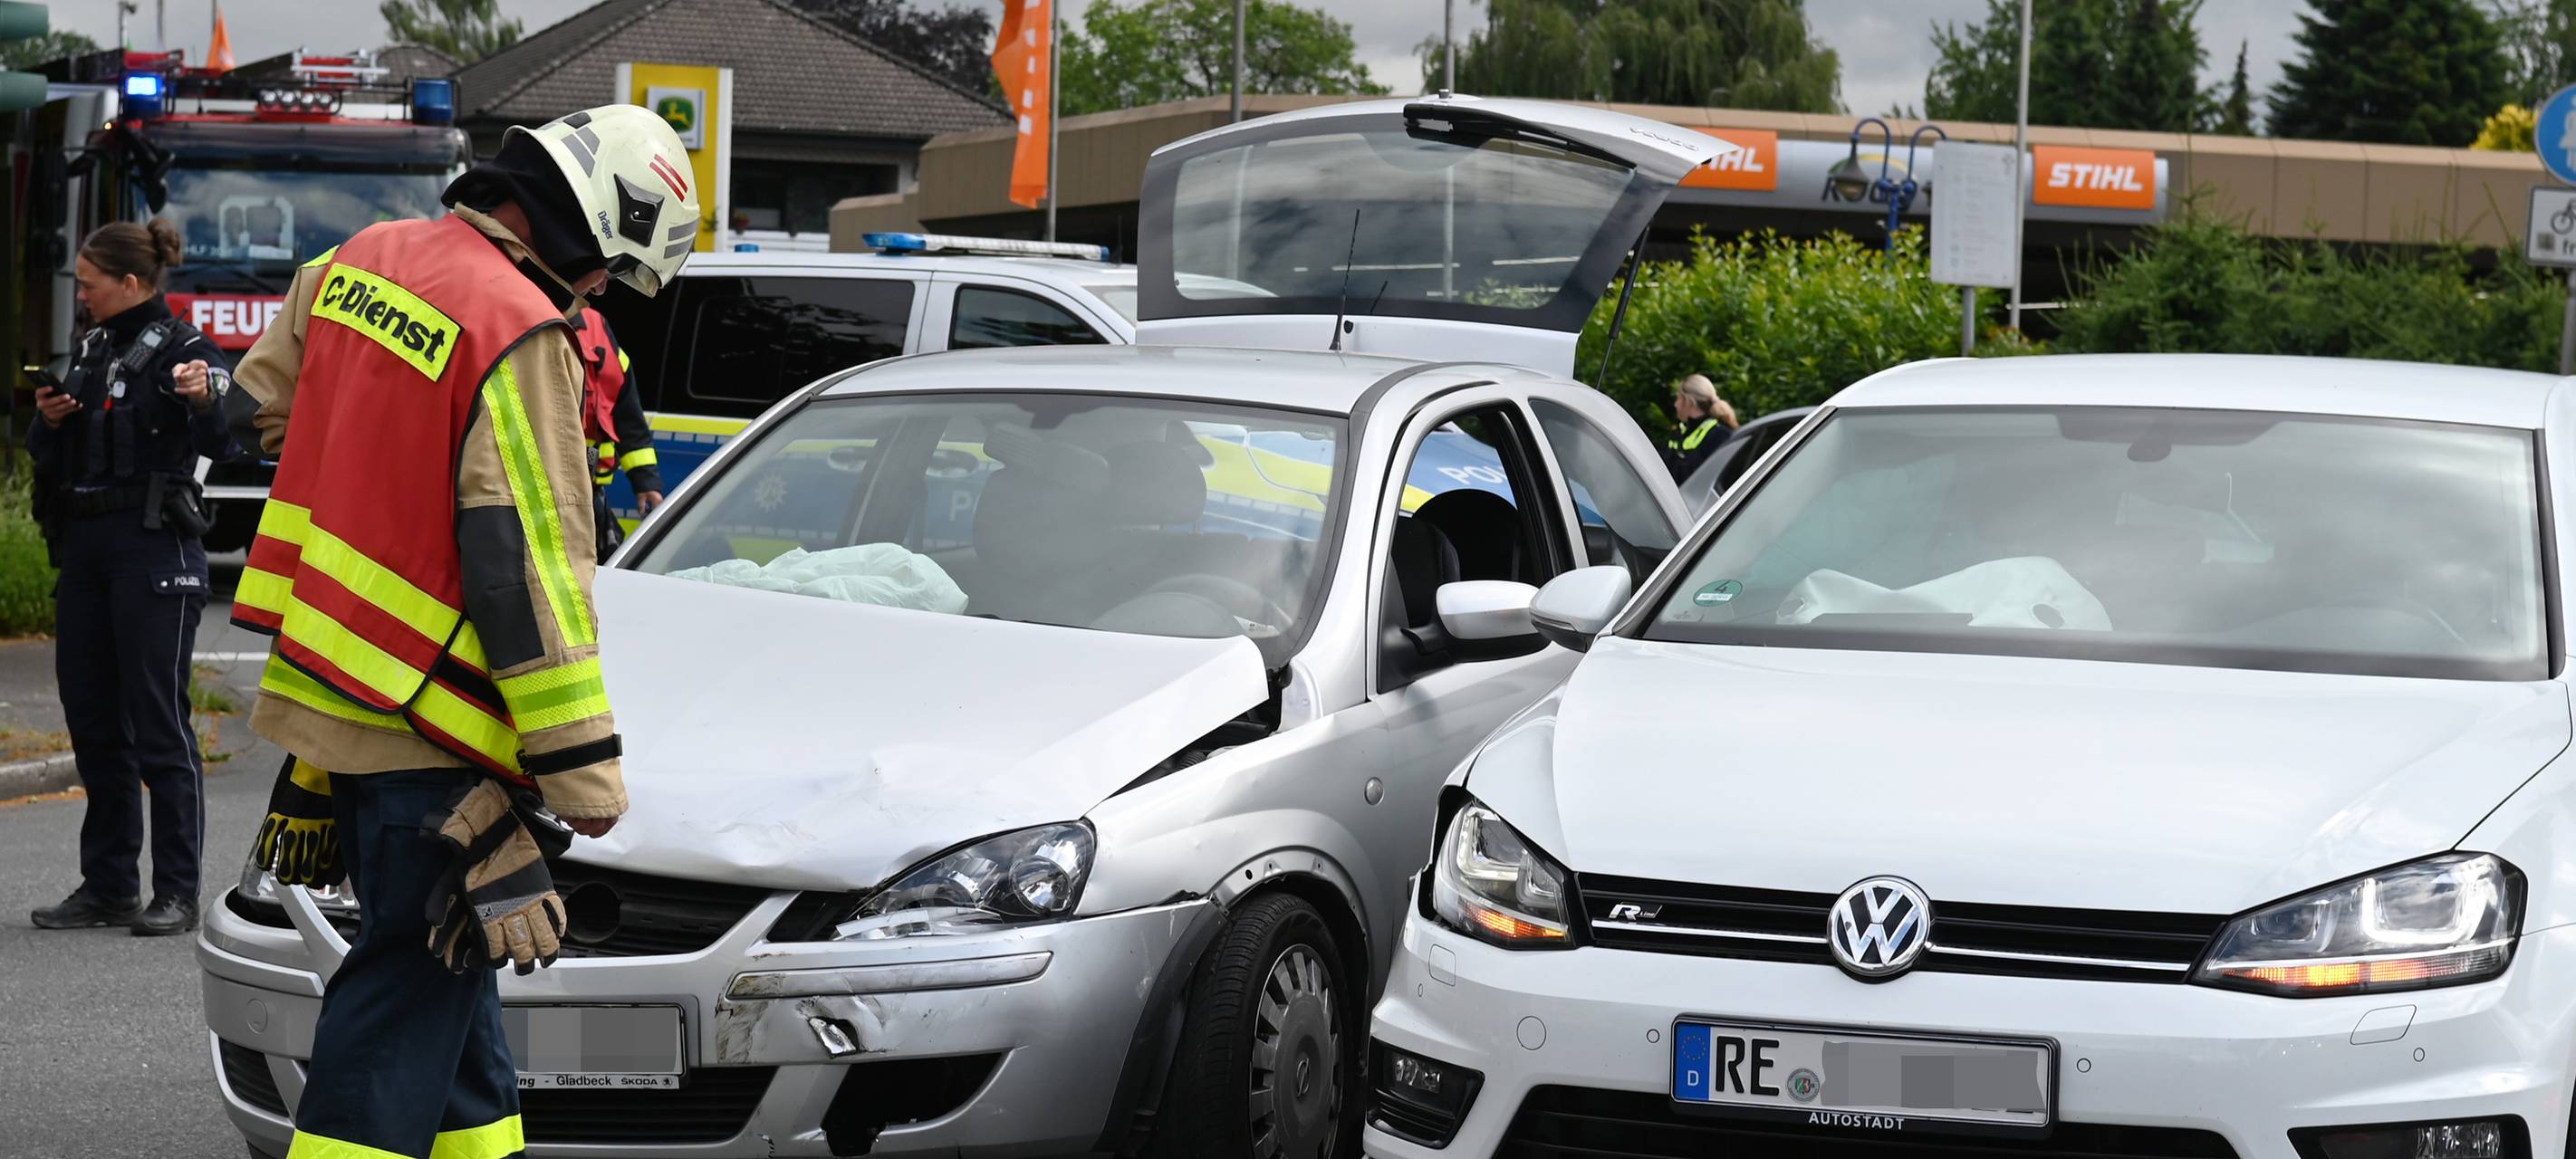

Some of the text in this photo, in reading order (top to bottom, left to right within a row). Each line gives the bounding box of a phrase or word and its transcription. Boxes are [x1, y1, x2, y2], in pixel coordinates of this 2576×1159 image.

[1697, 146, 1764, 172] IHL
[2047, 162, 2144, 192] STIHL
[597, 210, 613, 239] Dräger
[322, 274, 446, 364] C-Dienst
[174, 575, 200, 587] POLIZEI
[1714, 580, 1729, 593] 4
[1715, 1035, 1780, 1097] RE
[556, 1075, 612, 1086] Gladbeck
[1687, 1069, 1699, 1087] D
[1808, 1111, 1905, 1131] AUTOSTADT
